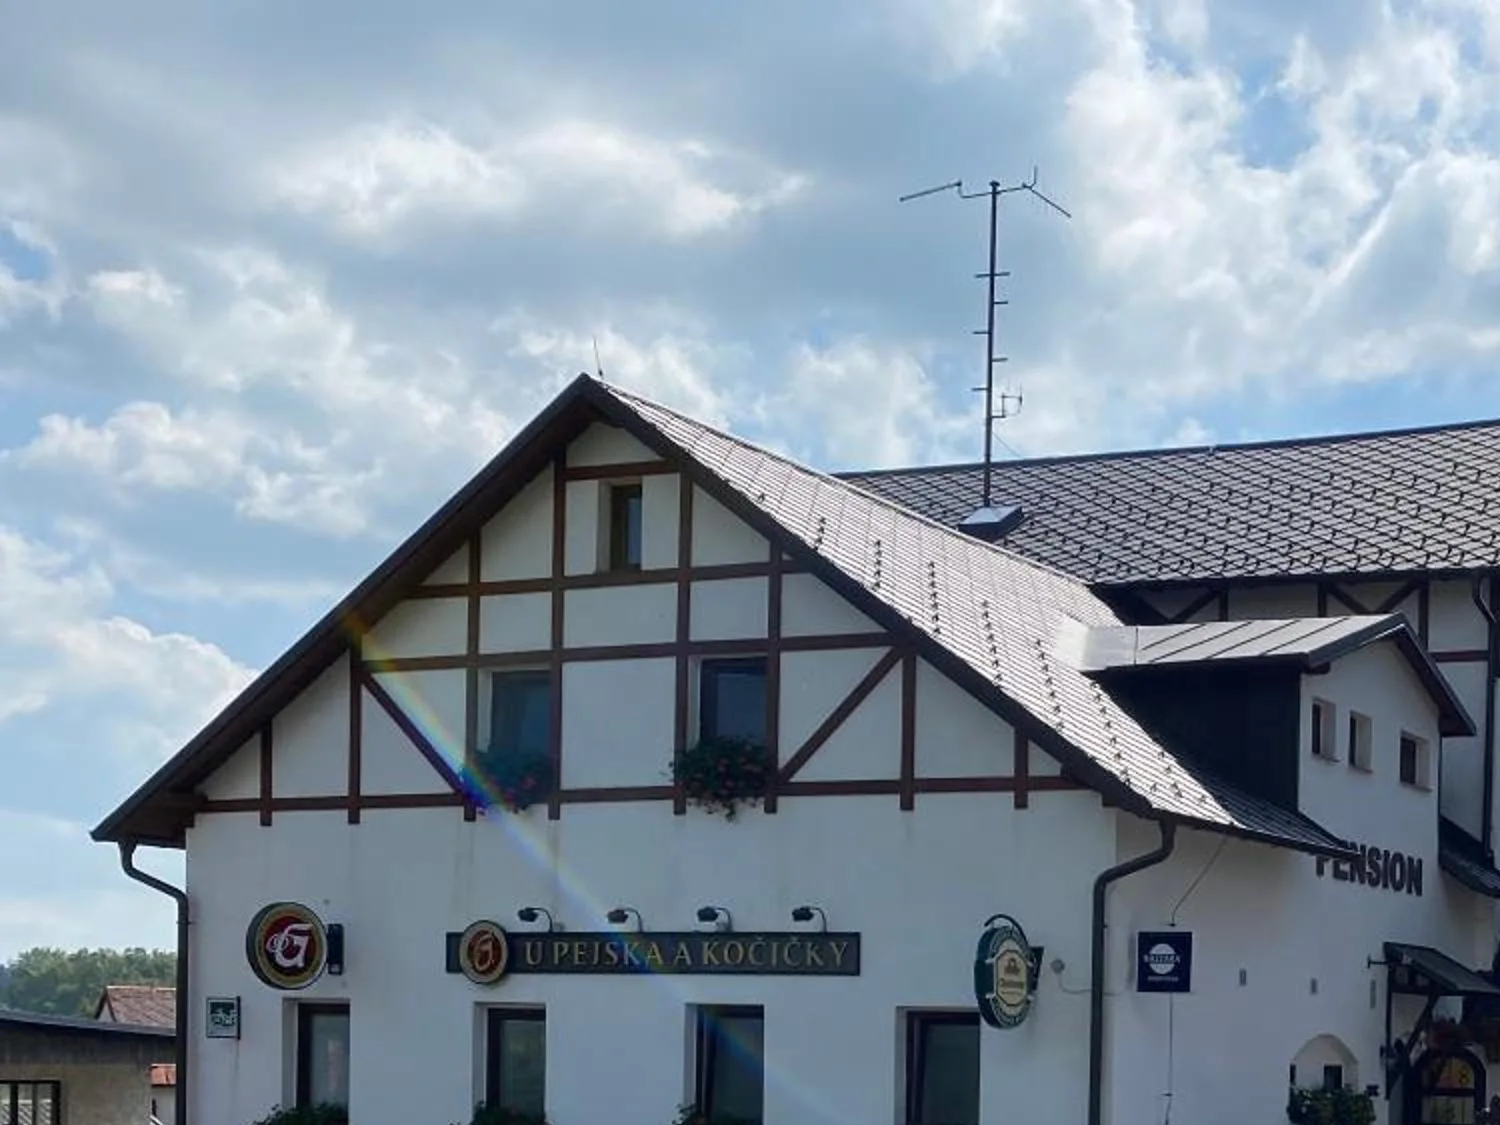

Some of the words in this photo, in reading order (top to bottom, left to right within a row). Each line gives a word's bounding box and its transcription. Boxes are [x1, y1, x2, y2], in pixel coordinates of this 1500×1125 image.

[1315, 842, 1424, 897] PENSION
[525, 941, 542, 965] U
[553, 941, 663, 965] PEJSKA
[673, 941, 692, 965] A
[703, 936, 848, 966] KOČIČKY
